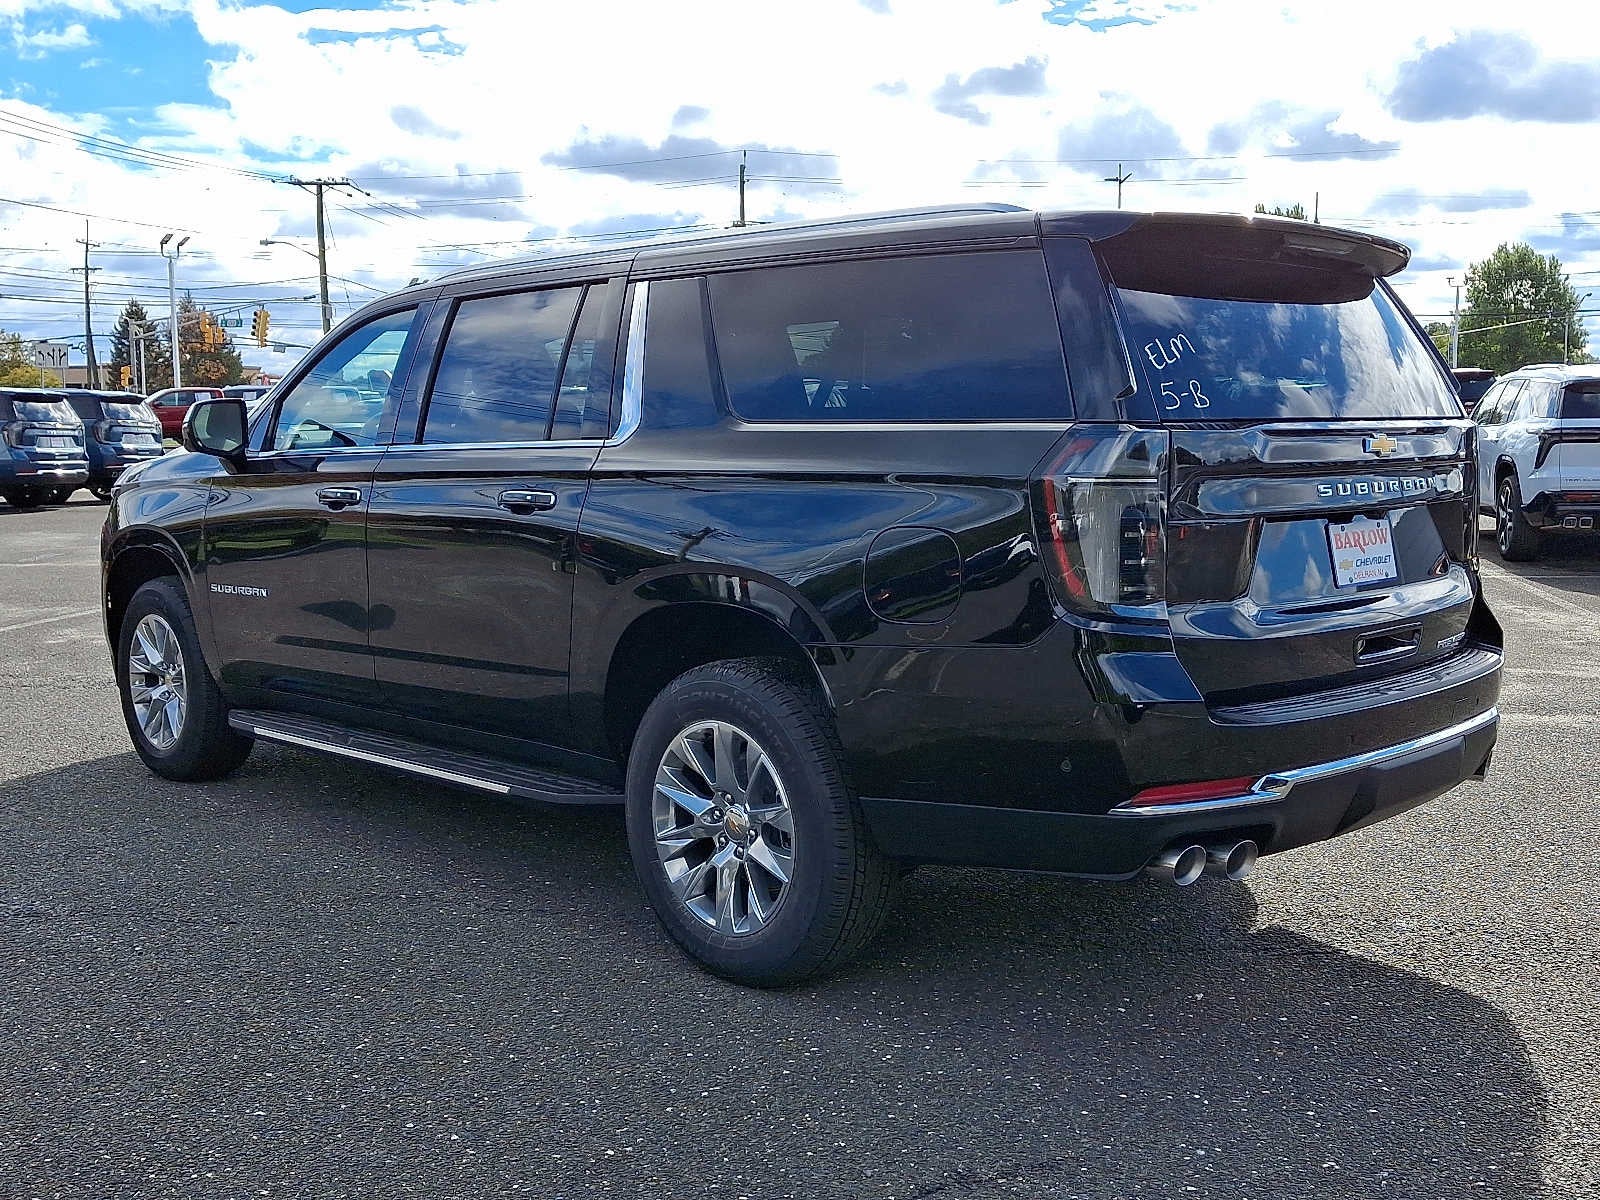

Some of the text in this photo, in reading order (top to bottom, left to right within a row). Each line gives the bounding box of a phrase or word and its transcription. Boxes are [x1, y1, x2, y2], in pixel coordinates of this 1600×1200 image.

[1144, 333, 1196, 370] ELM
[1160, 379, 1210, 410] 5-B
[1317, 476, 1436, 497] SUBURBAN
[1333, 527, 1388, 554] BARLOW
[1355, 554, 1392, 568] CHEVROLET
[209, 582, 268, 598] SUBURBAN
